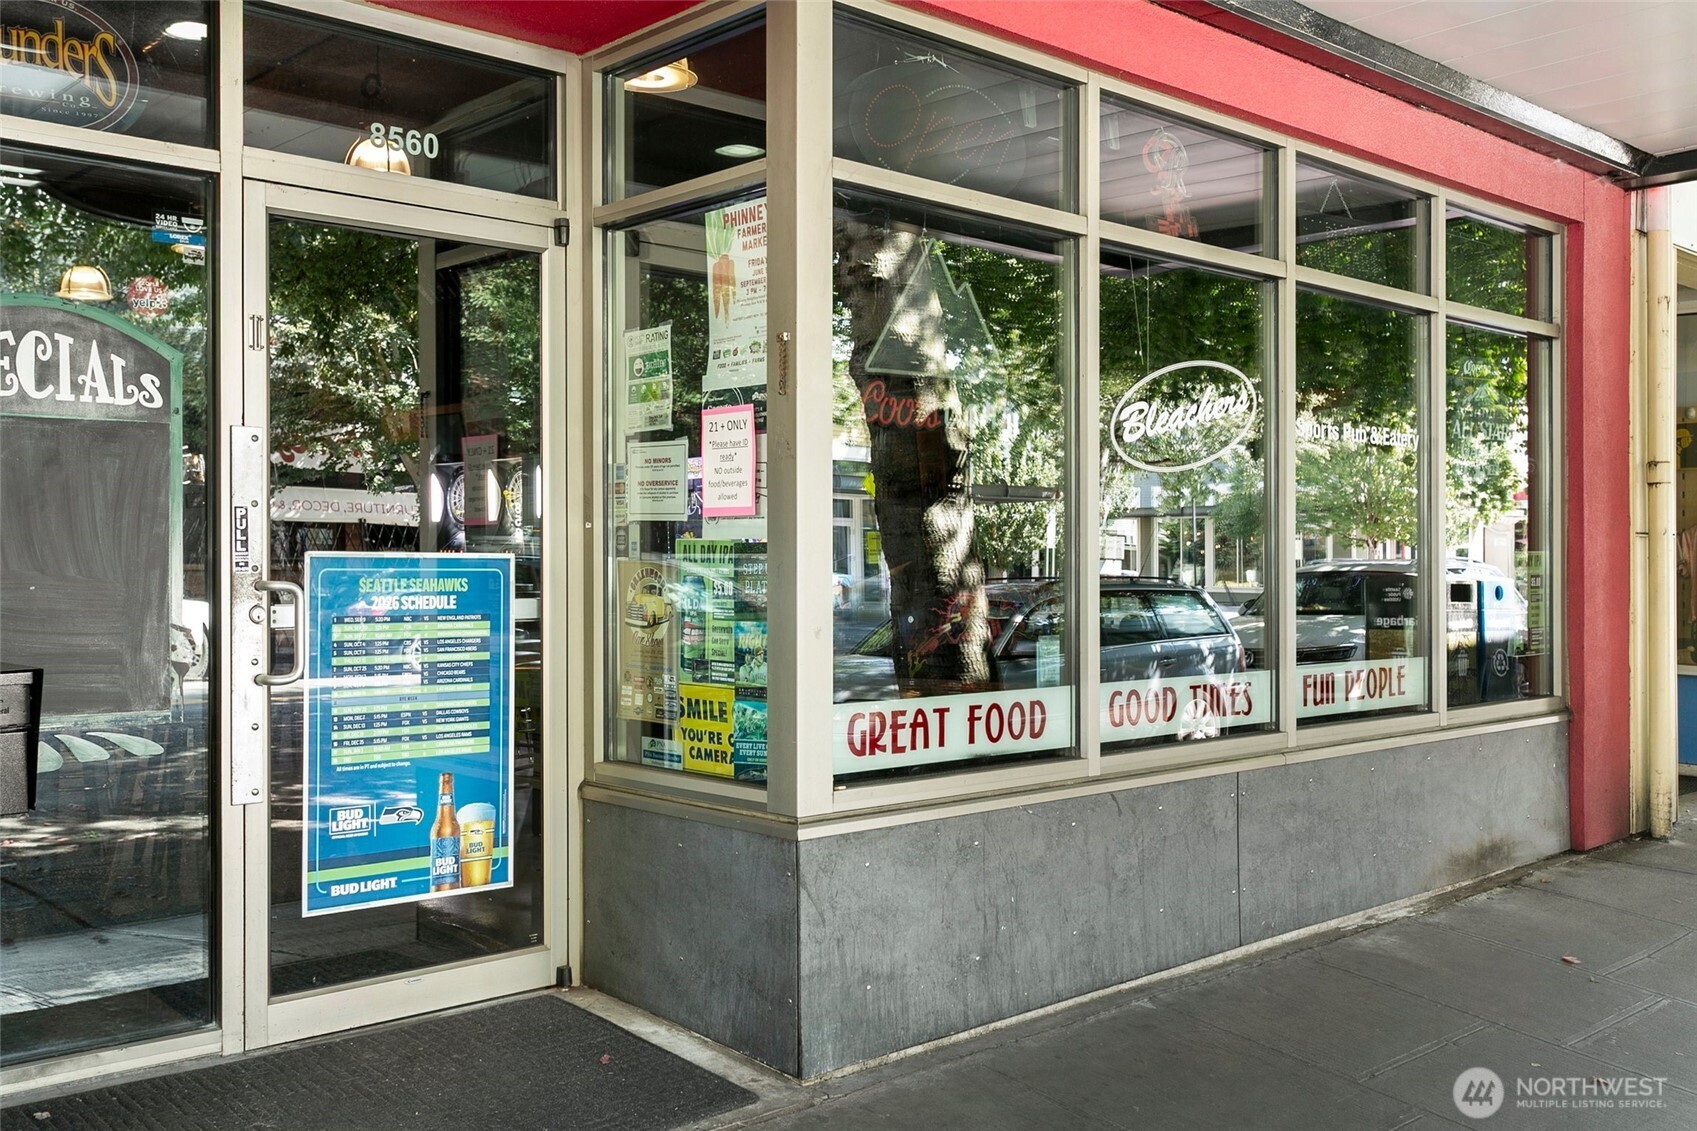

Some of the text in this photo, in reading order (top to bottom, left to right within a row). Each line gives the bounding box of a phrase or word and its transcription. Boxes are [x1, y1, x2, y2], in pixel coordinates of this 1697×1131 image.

[41, 107, 70, 115] Since
[370, 122, 439, 159] 8560
[156, 220, 178, 228] VIDEO
[132, 298, 157, 309] yelp
[645, 330, 669, 343] RATING
[1120, 383, 1250, 442] Bleachers
[709, 421, 718, 432] 21
[727, 419, 748, 431] ONLY
[729, 440, 742, 448] have
[1343, 421, 1366, 443] Pub
[1370, 425, 1382, 445] &
[1383, 427, 1419, 452] Eatery
[714, 467, 742, 475] NO outside
[718, 493, 738, 501] allowed
[236, 507, 247, 551] PULL
[682, 544, 734, 564] ALL DAY IPA
[359, 577, 468, 592] SEATTLE SEAHAWKS
[713, 580, 734, 596] $5.00
[401, 594, 457, 610] SCHEDULE
[1345, 664, 1406, 702] PEOPLE
[680, 696, 728, 723] SMILE
[1108, 681, 1252, 728] GOOD TIMES
[681, 726, 723, 746] YOU'RE
[847, 699, 1047, 758] GREAT FOOD
[688, 746, 734, 765] CAMERA
[337, 808, 364, 821] BUD
[332, 818, 369, 832] LIGHT
[466, 847, 486, 855] LIGHT
[435, 856, 456, 867] BUD
[432, 864, 459, 876] LIGHT
[331, 876, 398, 897] BUD LIGHT
